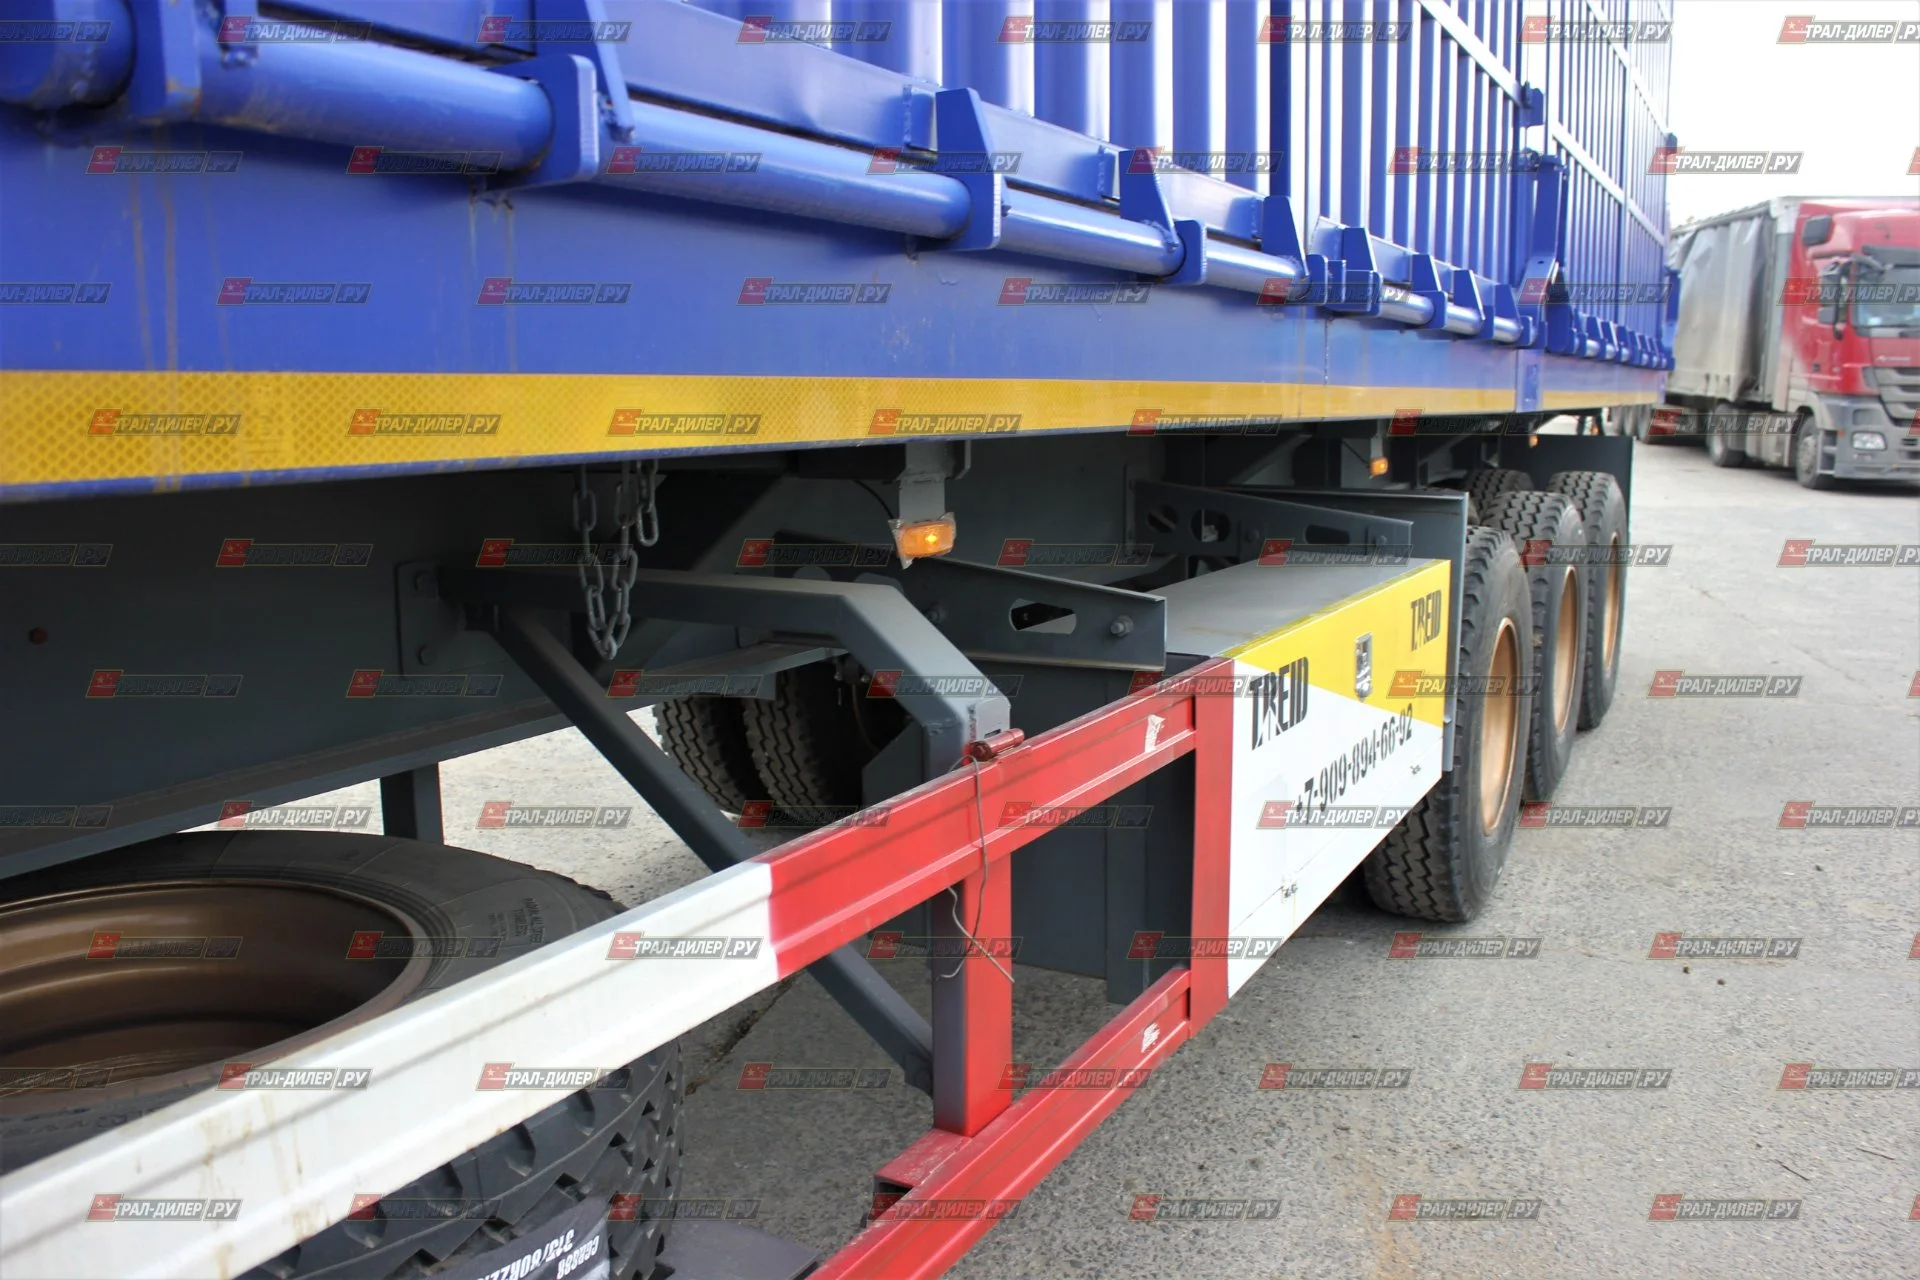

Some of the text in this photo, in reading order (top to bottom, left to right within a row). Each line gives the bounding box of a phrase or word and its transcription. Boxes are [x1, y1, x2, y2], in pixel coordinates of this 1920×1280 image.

[1411, 589, 1441, 651] TREID
[1249, 656, 1309, 750] TREID
[1297, 703, 1413, 825] +7-909-894-66-92
